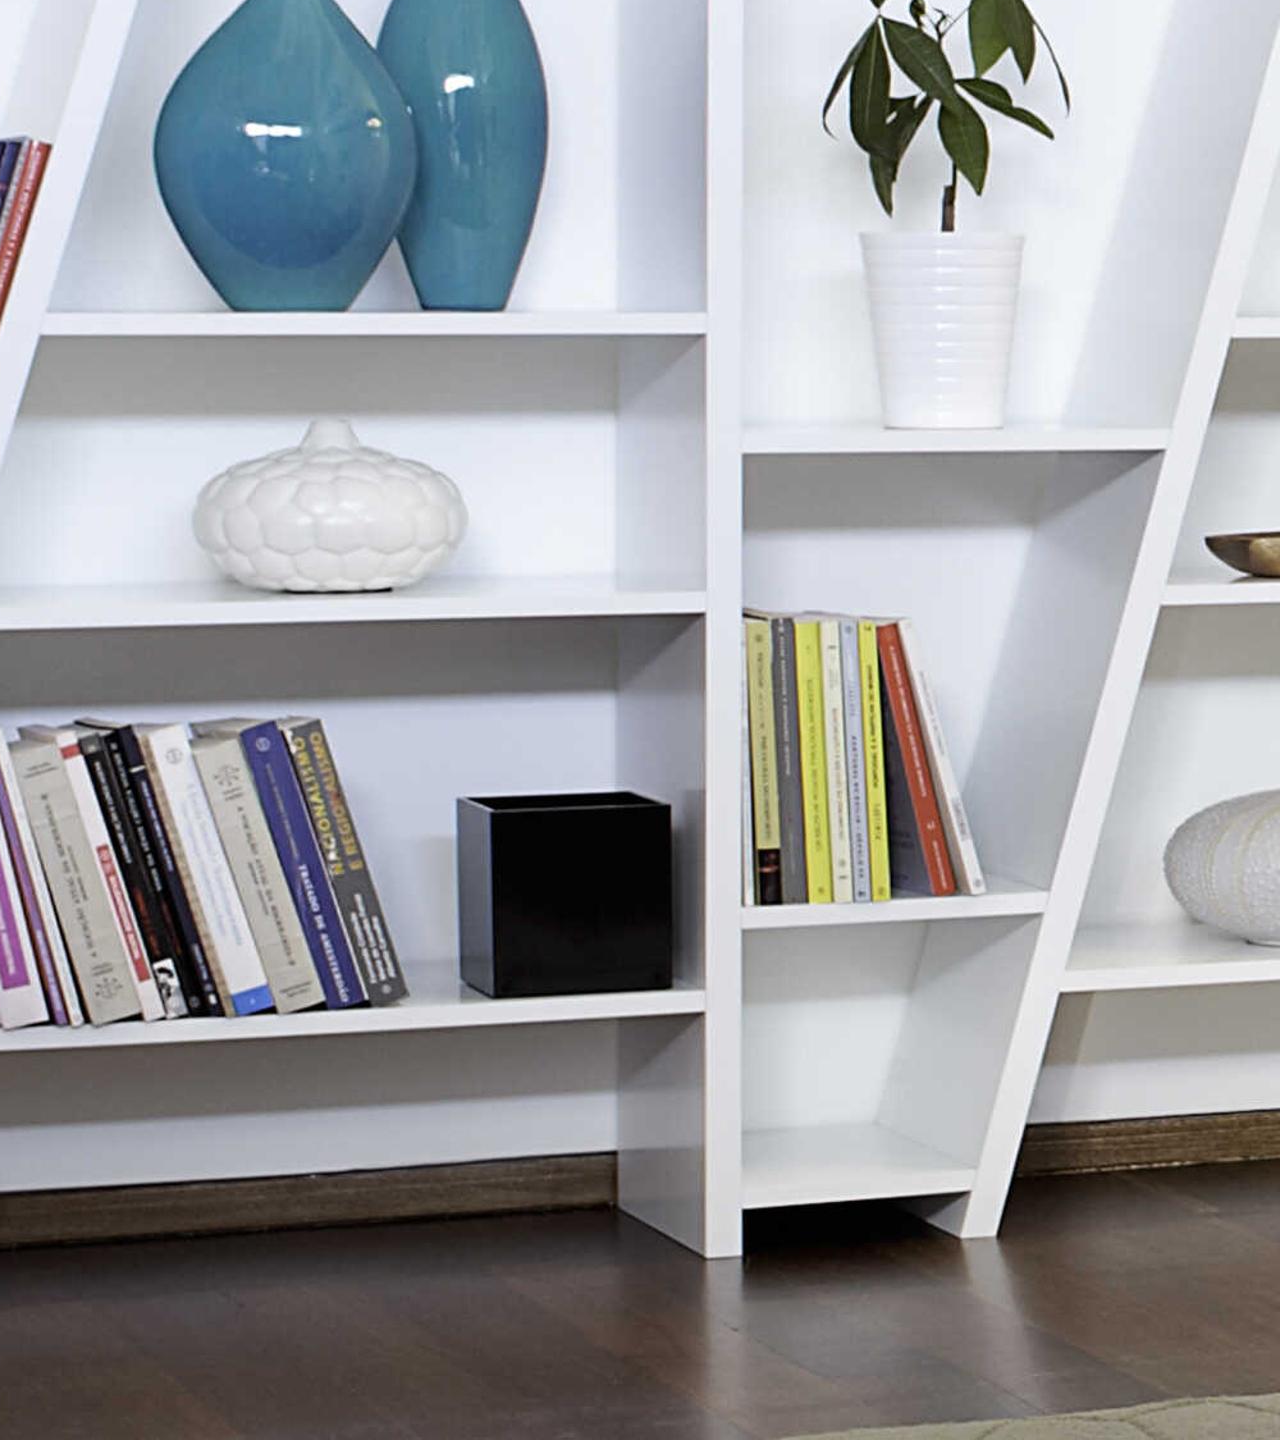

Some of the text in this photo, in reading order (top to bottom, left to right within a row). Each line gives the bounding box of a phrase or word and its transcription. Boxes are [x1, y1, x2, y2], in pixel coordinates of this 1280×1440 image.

[293, 737, 345, 876] NACIONALISMO
[299, 863, 320, 912] TRATADO
[314, 914, 326, 930] DE
